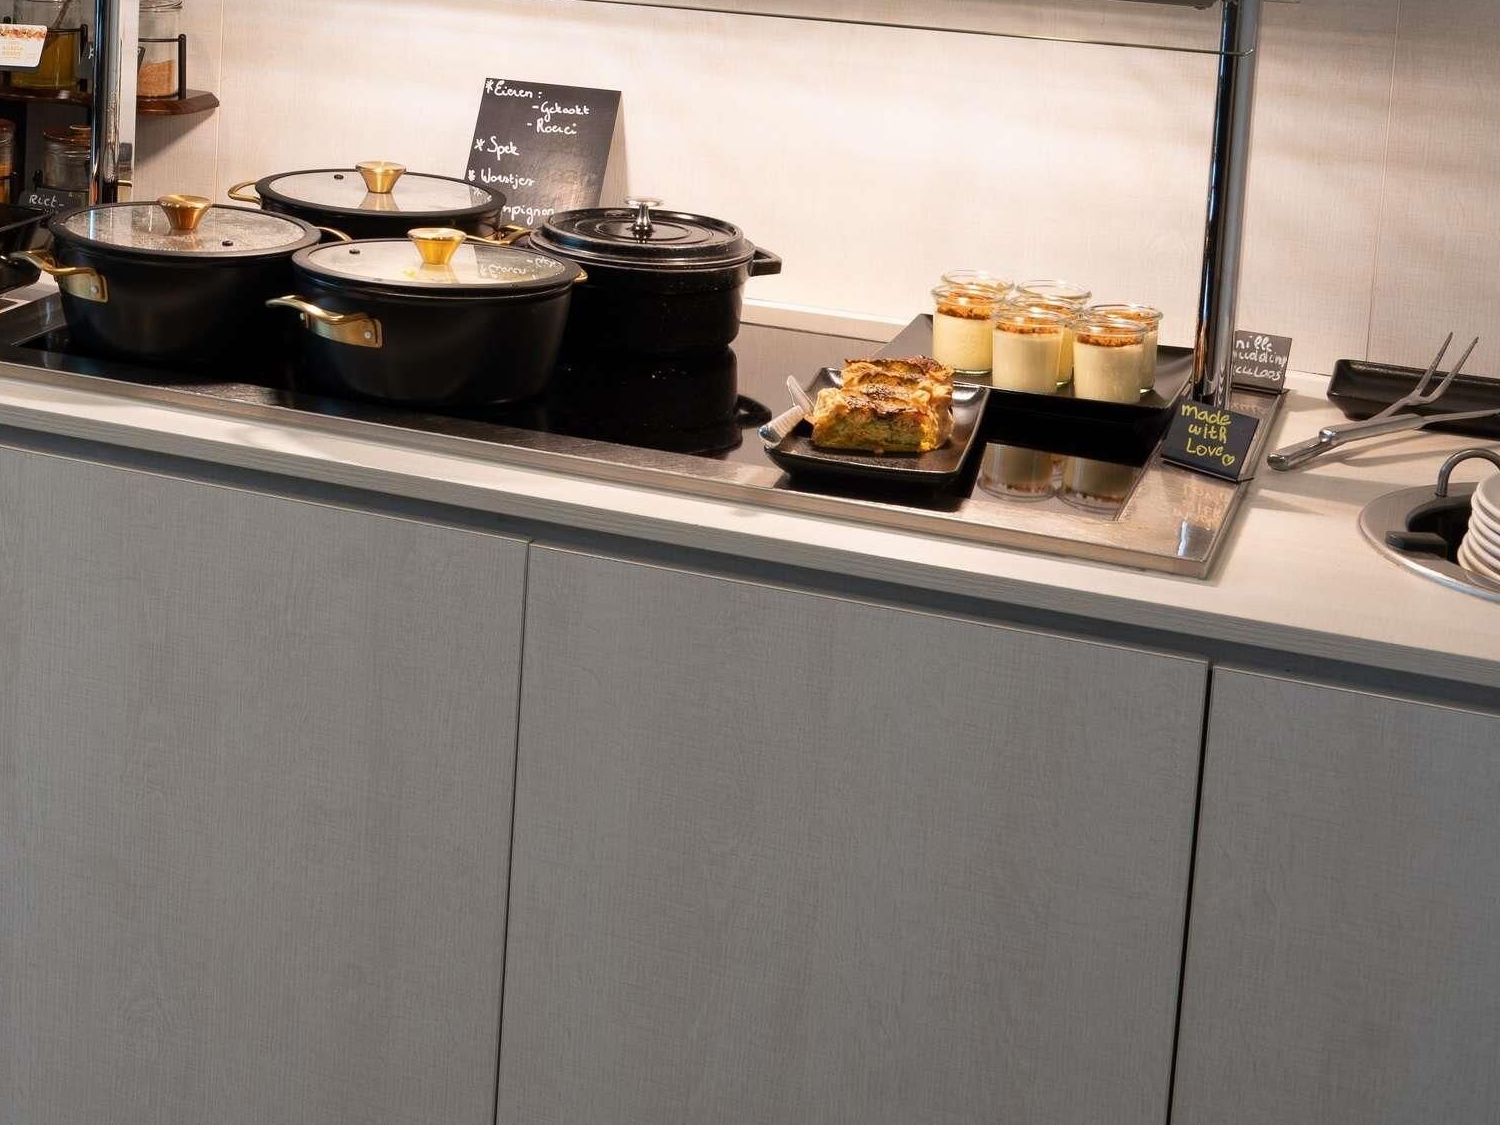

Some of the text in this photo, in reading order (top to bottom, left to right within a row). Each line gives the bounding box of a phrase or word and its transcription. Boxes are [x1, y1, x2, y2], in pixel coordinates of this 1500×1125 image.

[487, 136, 520, 161] Spek
[1181, 404, 1232, 426] made
[1188, 424, 1227, 444] with
[1186, 437, 1224, 457] Love
